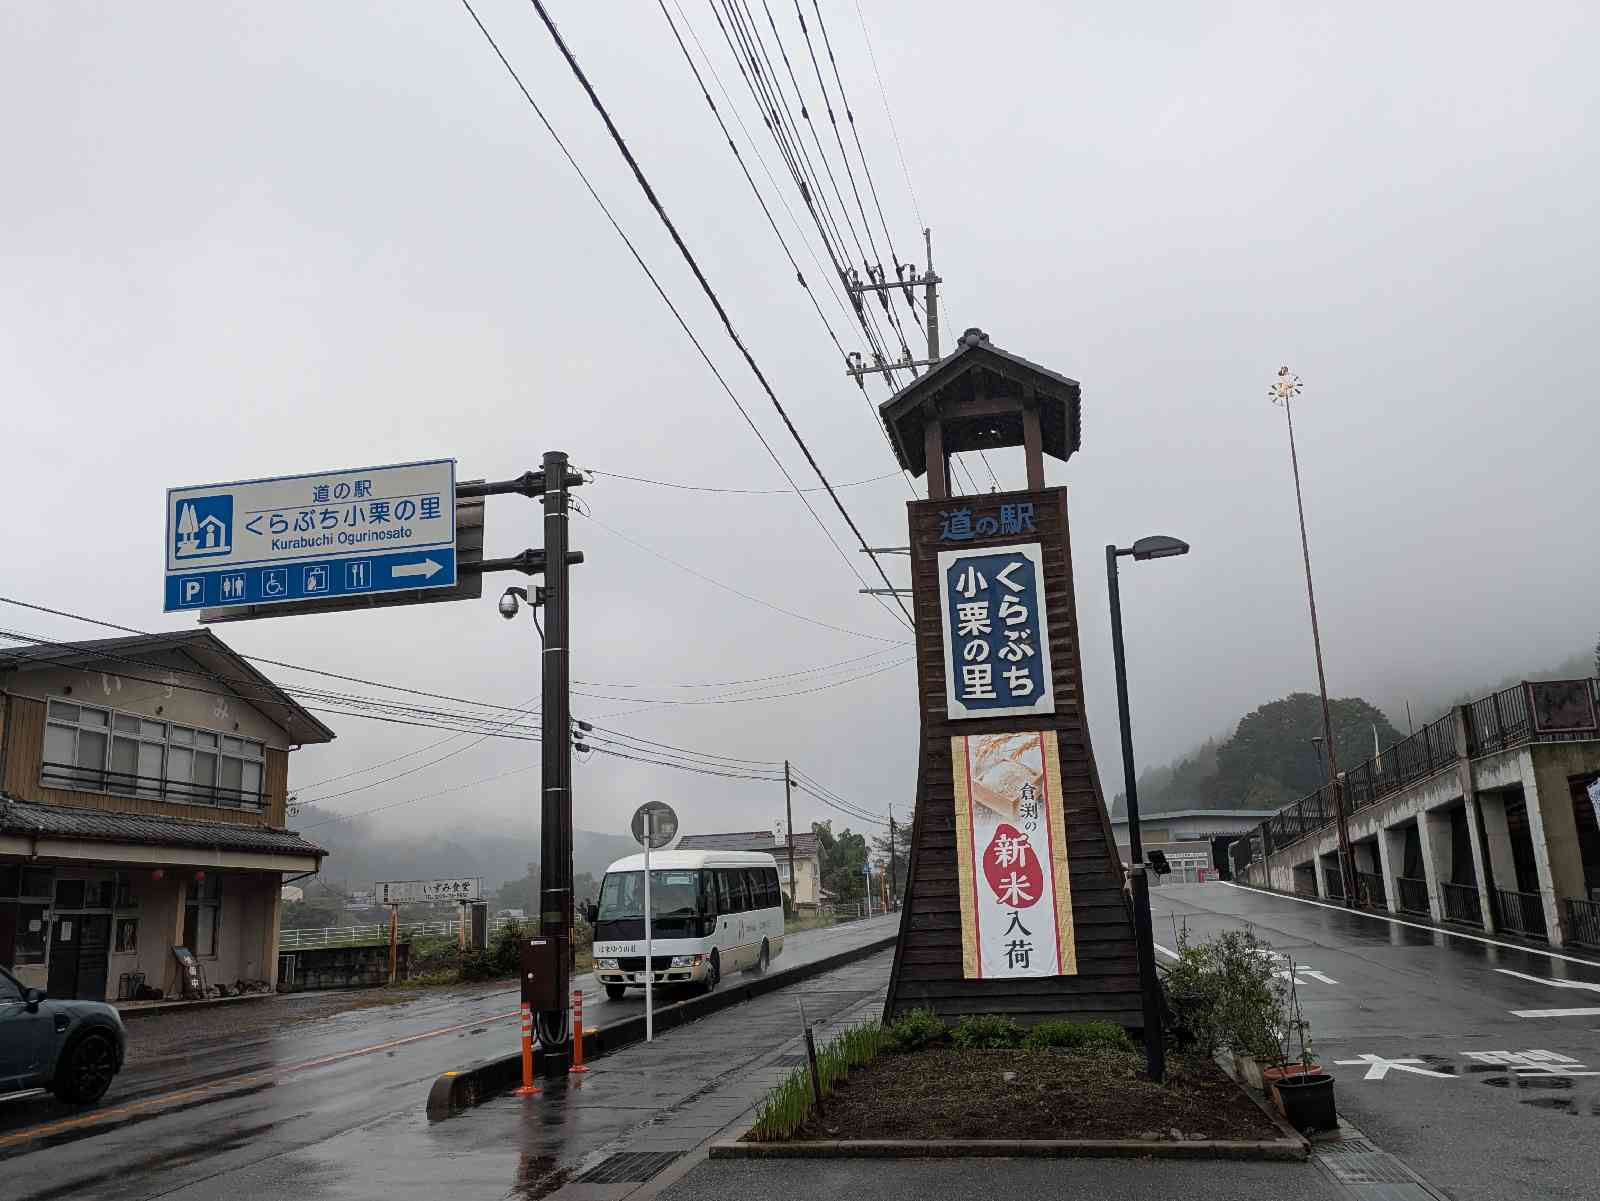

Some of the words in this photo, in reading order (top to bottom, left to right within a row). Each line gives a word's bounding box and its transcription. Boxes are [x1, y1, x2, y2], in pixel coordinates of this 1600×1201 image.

[313, 480, 372, 503] 道の駅
[245, 496, 441, 535] くらぶち小栗の里
[939, 502, 1037, 541] 道の駅
[271, 533, 333, 550] Kurabuchi
[338, 527, 412, 545] Ogurinosato
[955, 565, 997, 700] 小栗の里
[996, 561, 1035, 697] くらぶち
[1019, 782, 1039, 831] 倉渕の
